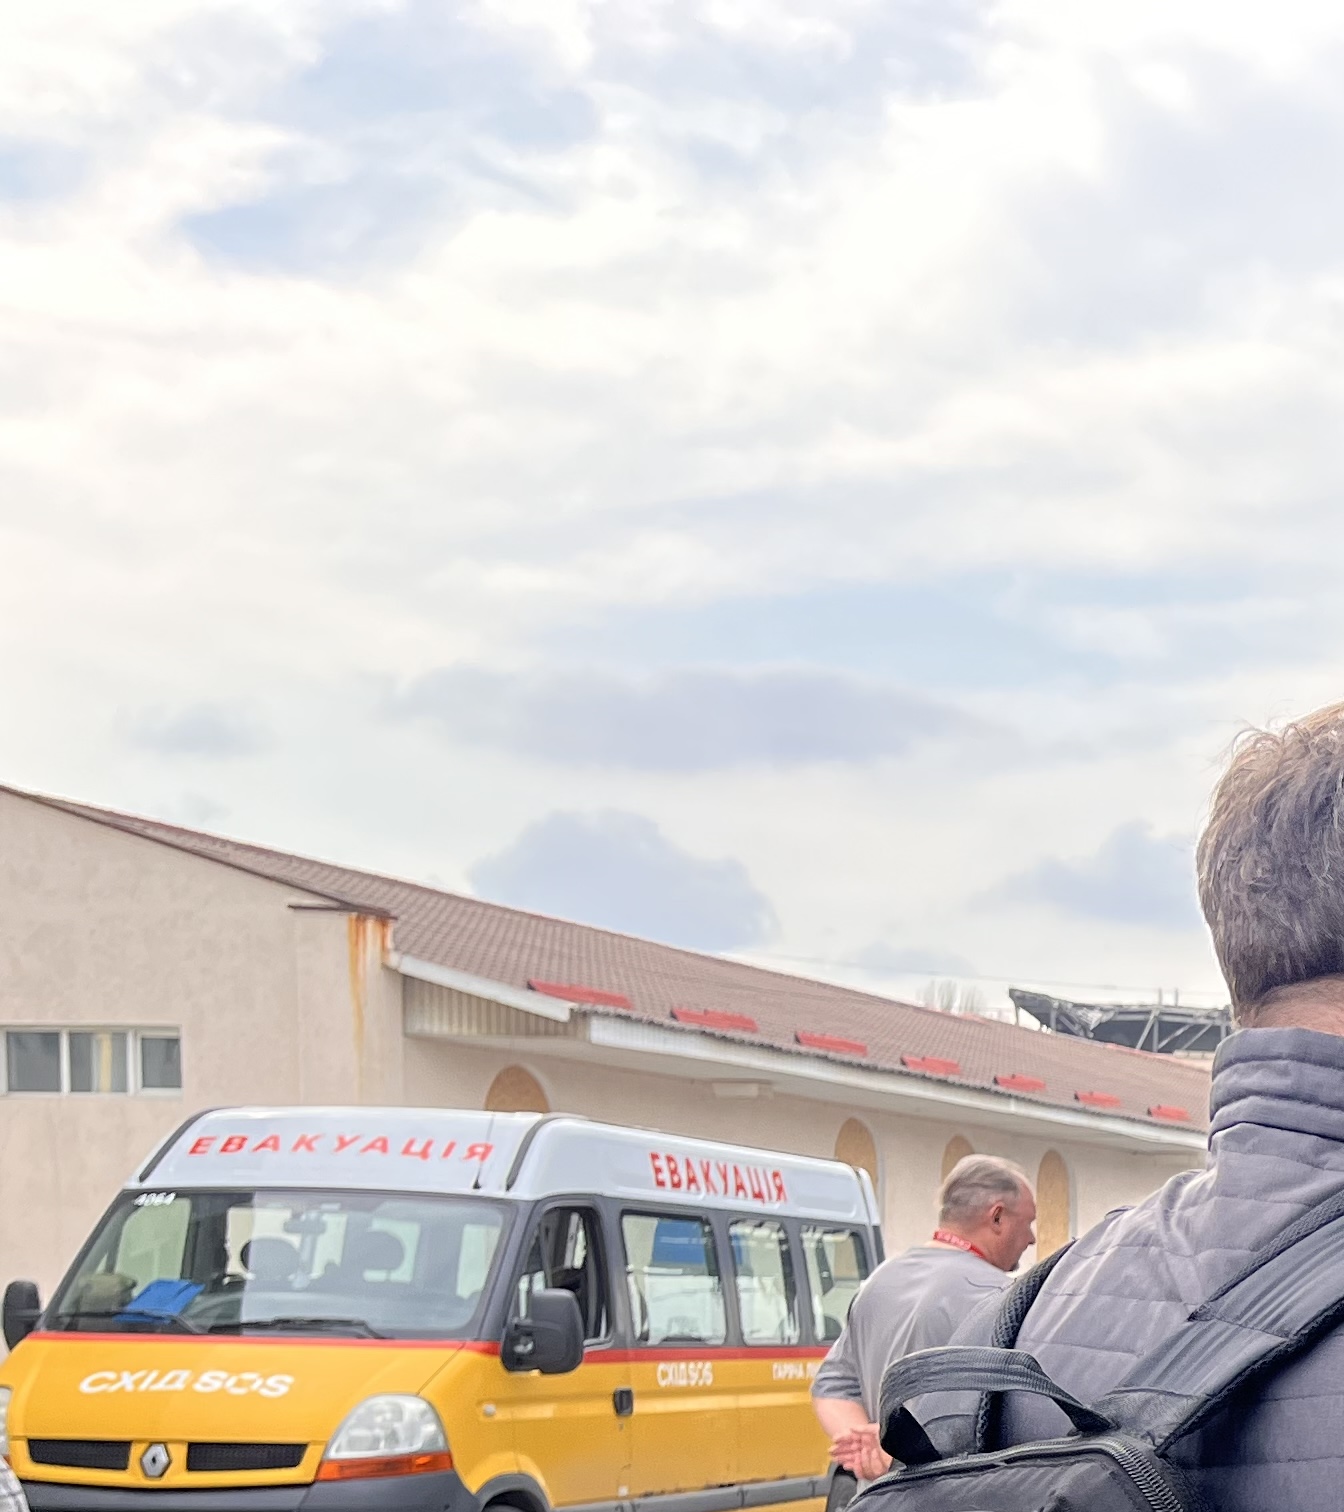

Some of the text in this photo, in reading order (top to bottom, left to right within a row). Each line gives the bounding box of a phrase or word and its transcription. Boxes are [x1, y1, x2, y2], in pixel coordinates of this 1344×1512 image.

[188, 1133, 495, 1162] ЕВАКУАЦІЯ
[649, 1152, 788, 1204] ЕВАКУАЦІЯ
[79, 1370, 294, 1398] СХІД SOS
